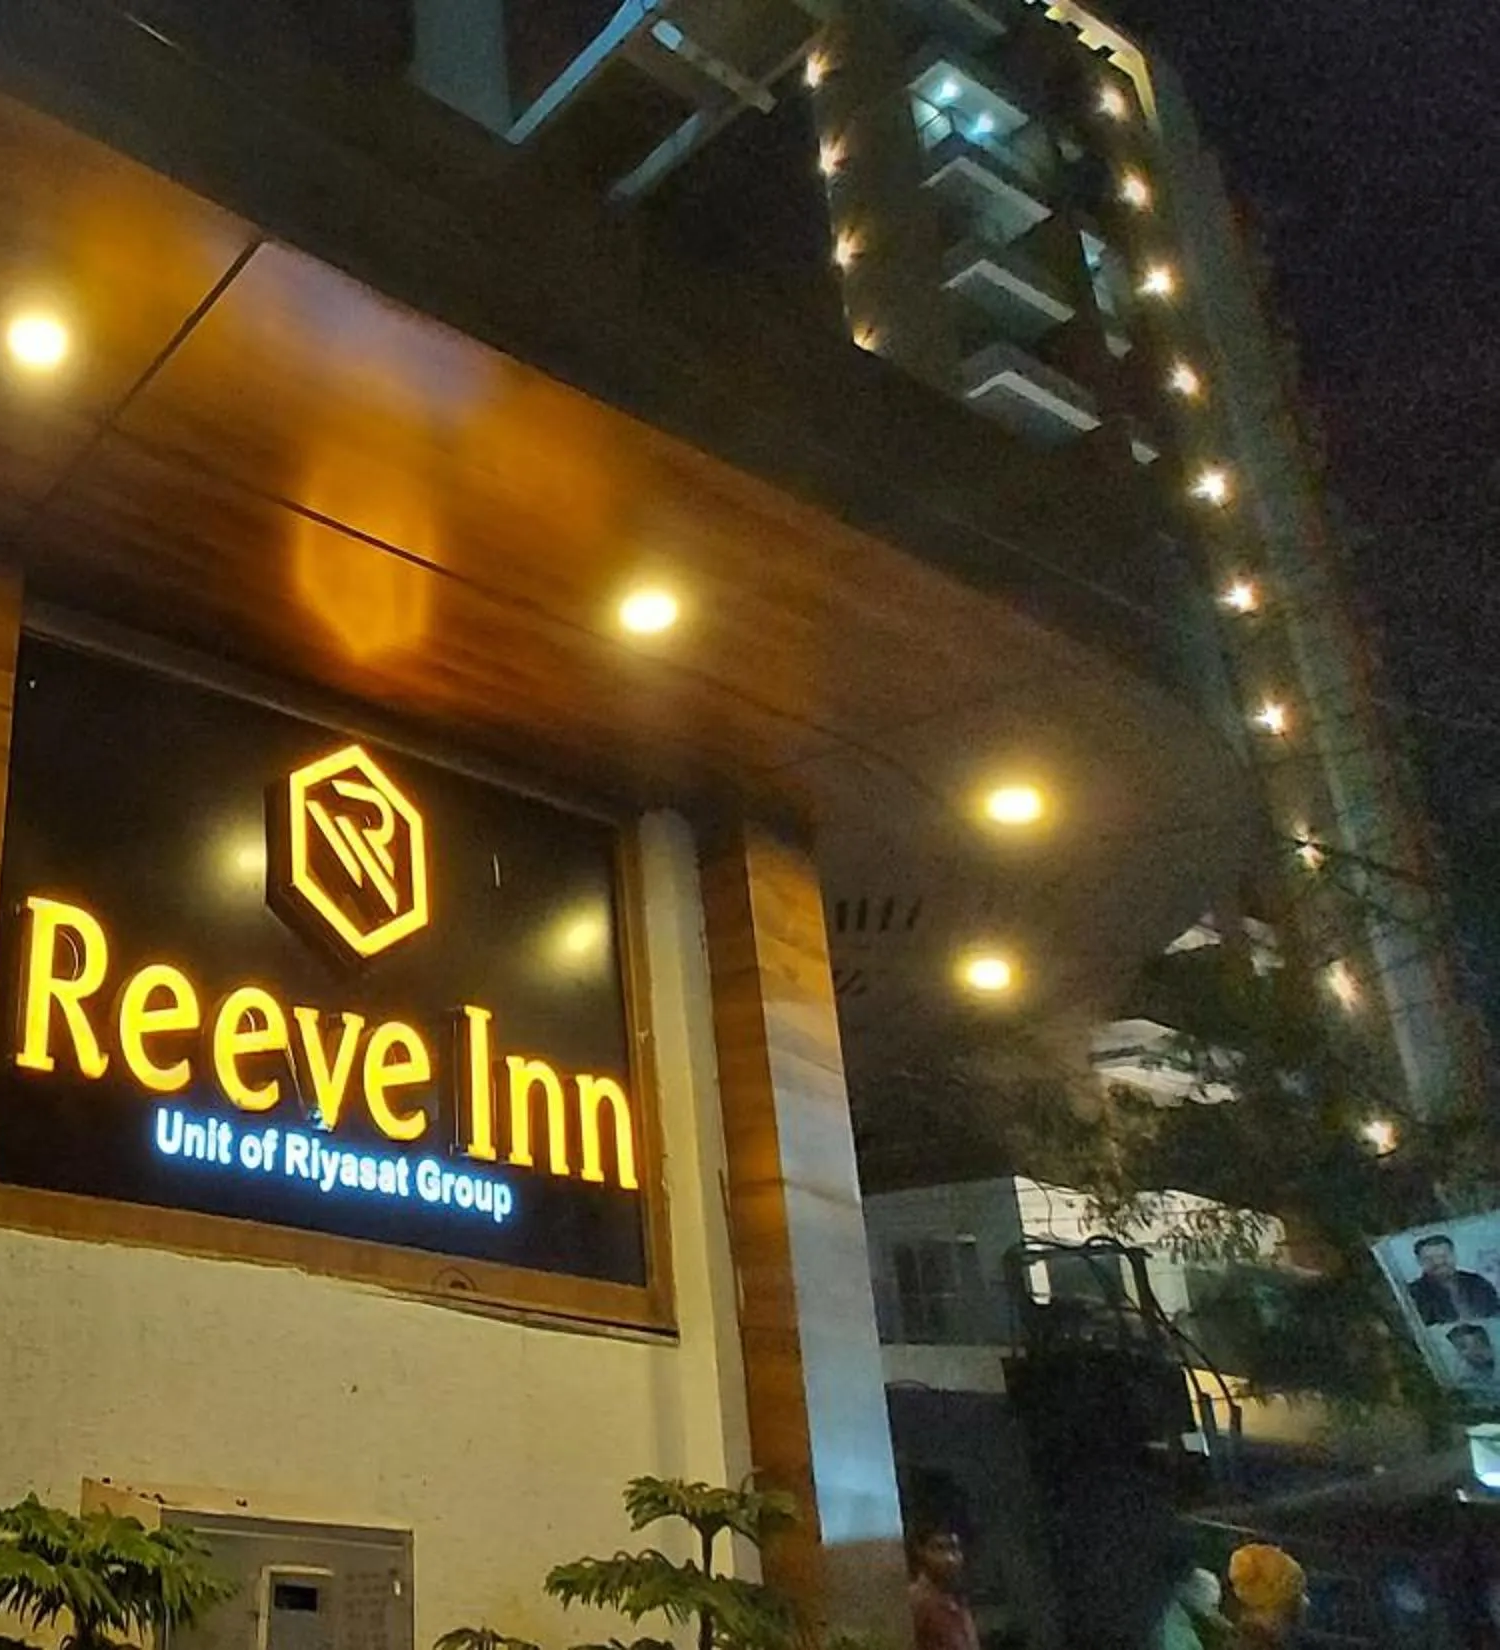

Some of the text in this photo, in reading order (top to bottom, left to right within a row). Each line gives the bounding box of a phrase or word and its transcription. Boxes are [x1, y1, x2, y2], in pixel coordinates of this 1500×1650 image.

[16, 895, 638, 1190] Reeve Inn
[156, 1107, 513, 1223] Unit of Riyasat Group
